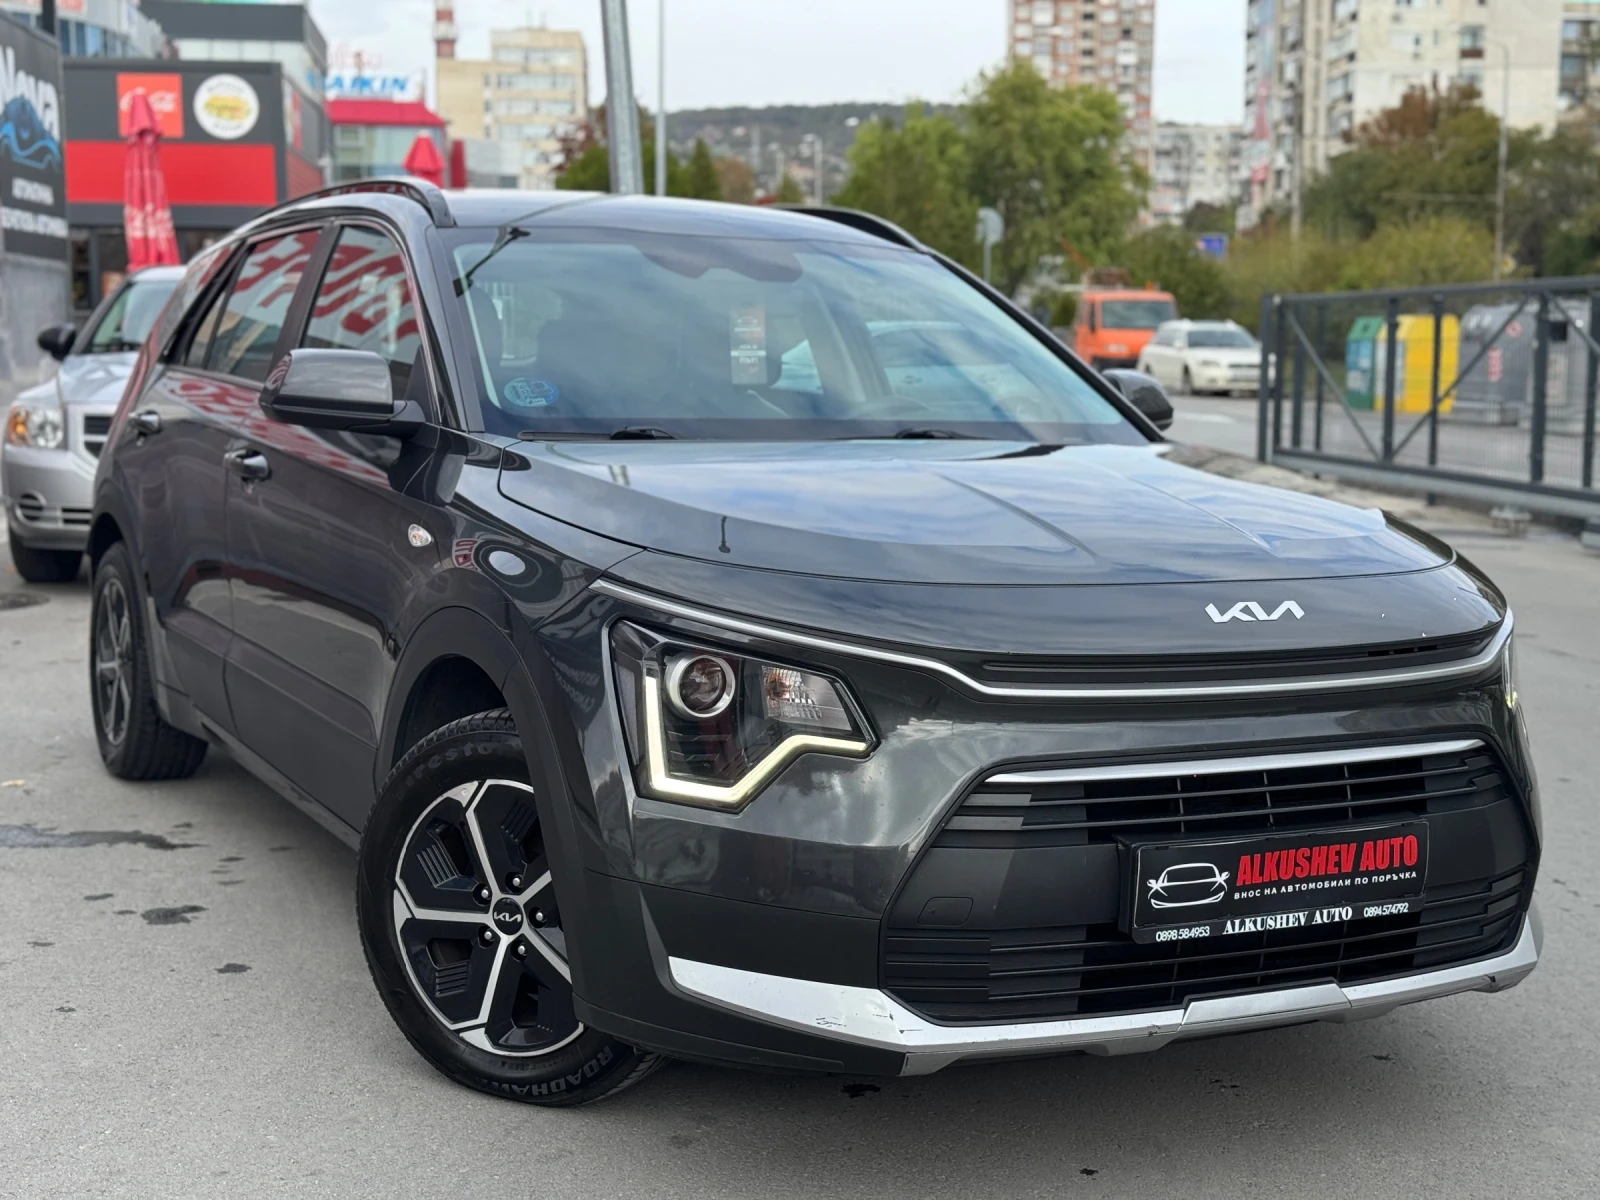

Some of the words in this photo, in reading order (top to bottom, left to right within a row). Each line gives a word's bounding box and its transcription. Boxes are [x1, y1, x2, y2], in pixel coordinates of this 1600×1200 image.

[1204, 601, 1305, 622] KIA
[1236, 843, 1357, 886] ALKUSHEV
[1359, 835, 1418, 872] AUTO
[1234, 889, 1261, 900] ВНОС
[1264, 886, 1278, 896] НА
[1280, 878, 1351, 894] АВТОМОБИЛИ
[1354, 876, 1369, 886] ПО
[1372, 871, 1417, 883] ПОРЪЧКА
[1222, 911, 1309, 935] ALKUSHEV
[1311, 906, 1353, 925] AUTO
